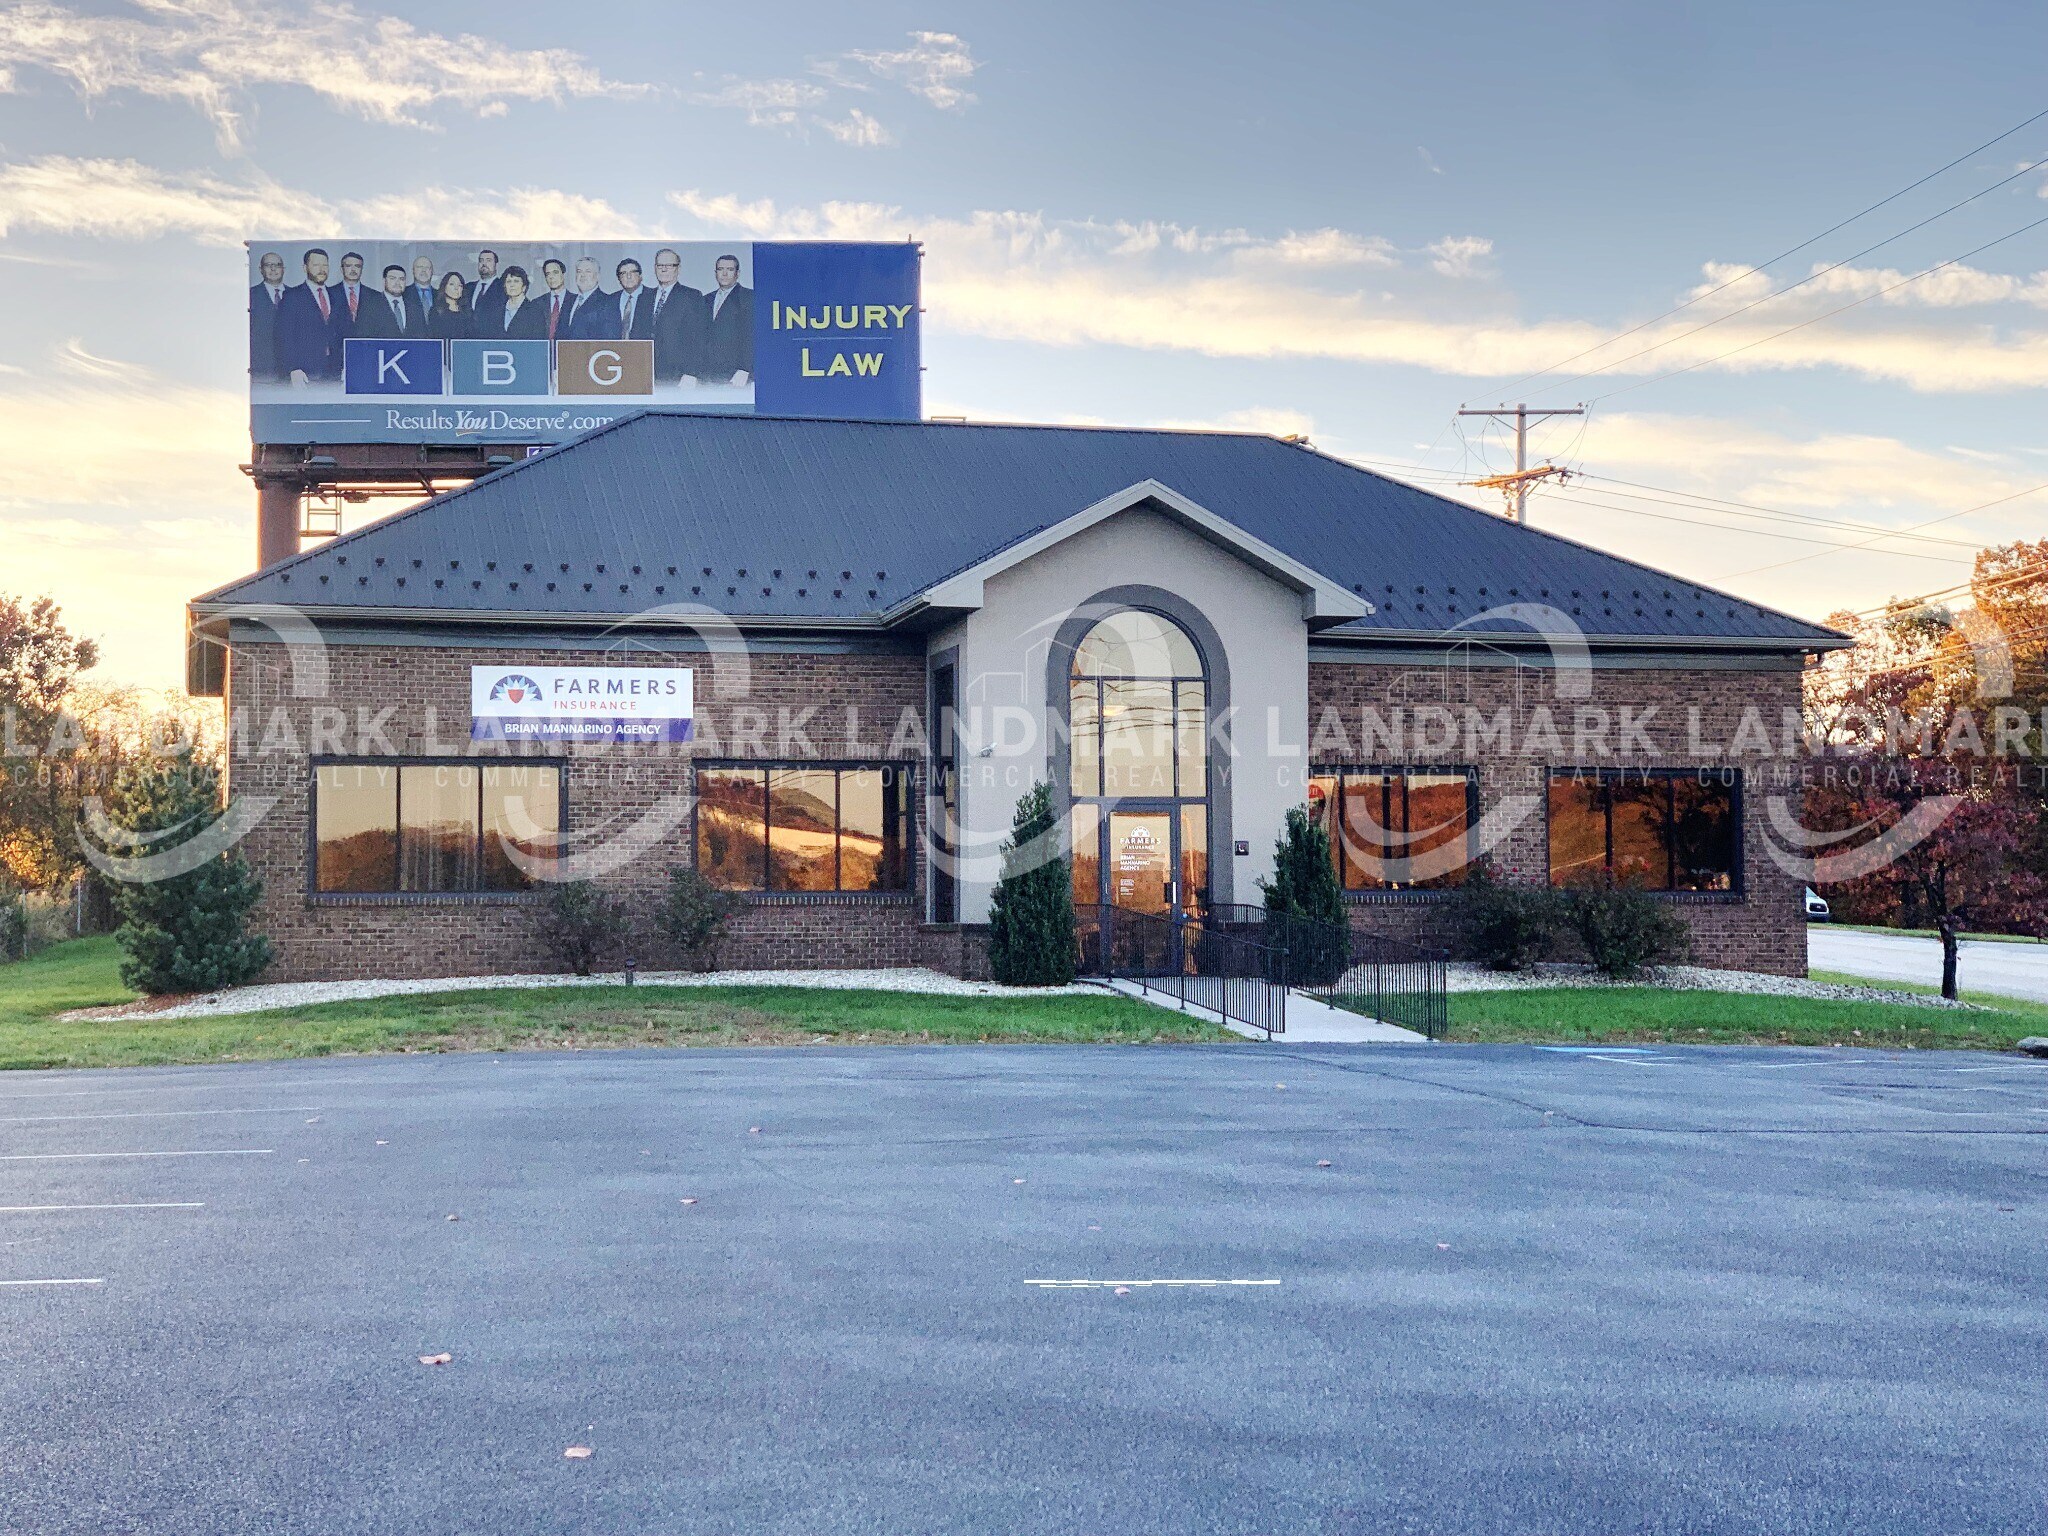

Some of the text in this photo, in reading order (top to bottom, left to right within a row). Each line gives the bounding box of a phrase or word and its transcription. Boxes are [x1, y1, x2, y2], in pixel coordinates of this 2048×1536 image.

[772, 300, 914, 330] INJURY
[377, 349, 623, 386] K B G
[801, 347, 884, 377] LAW
[553, 678, 677, 695] FARMERS
[553, 700, 638, 711] INSURANCE
[504, 723, 662, 736] BRIAN MANNARINO AGENCY
[1119, 837, 1162, 845] FARMERS
